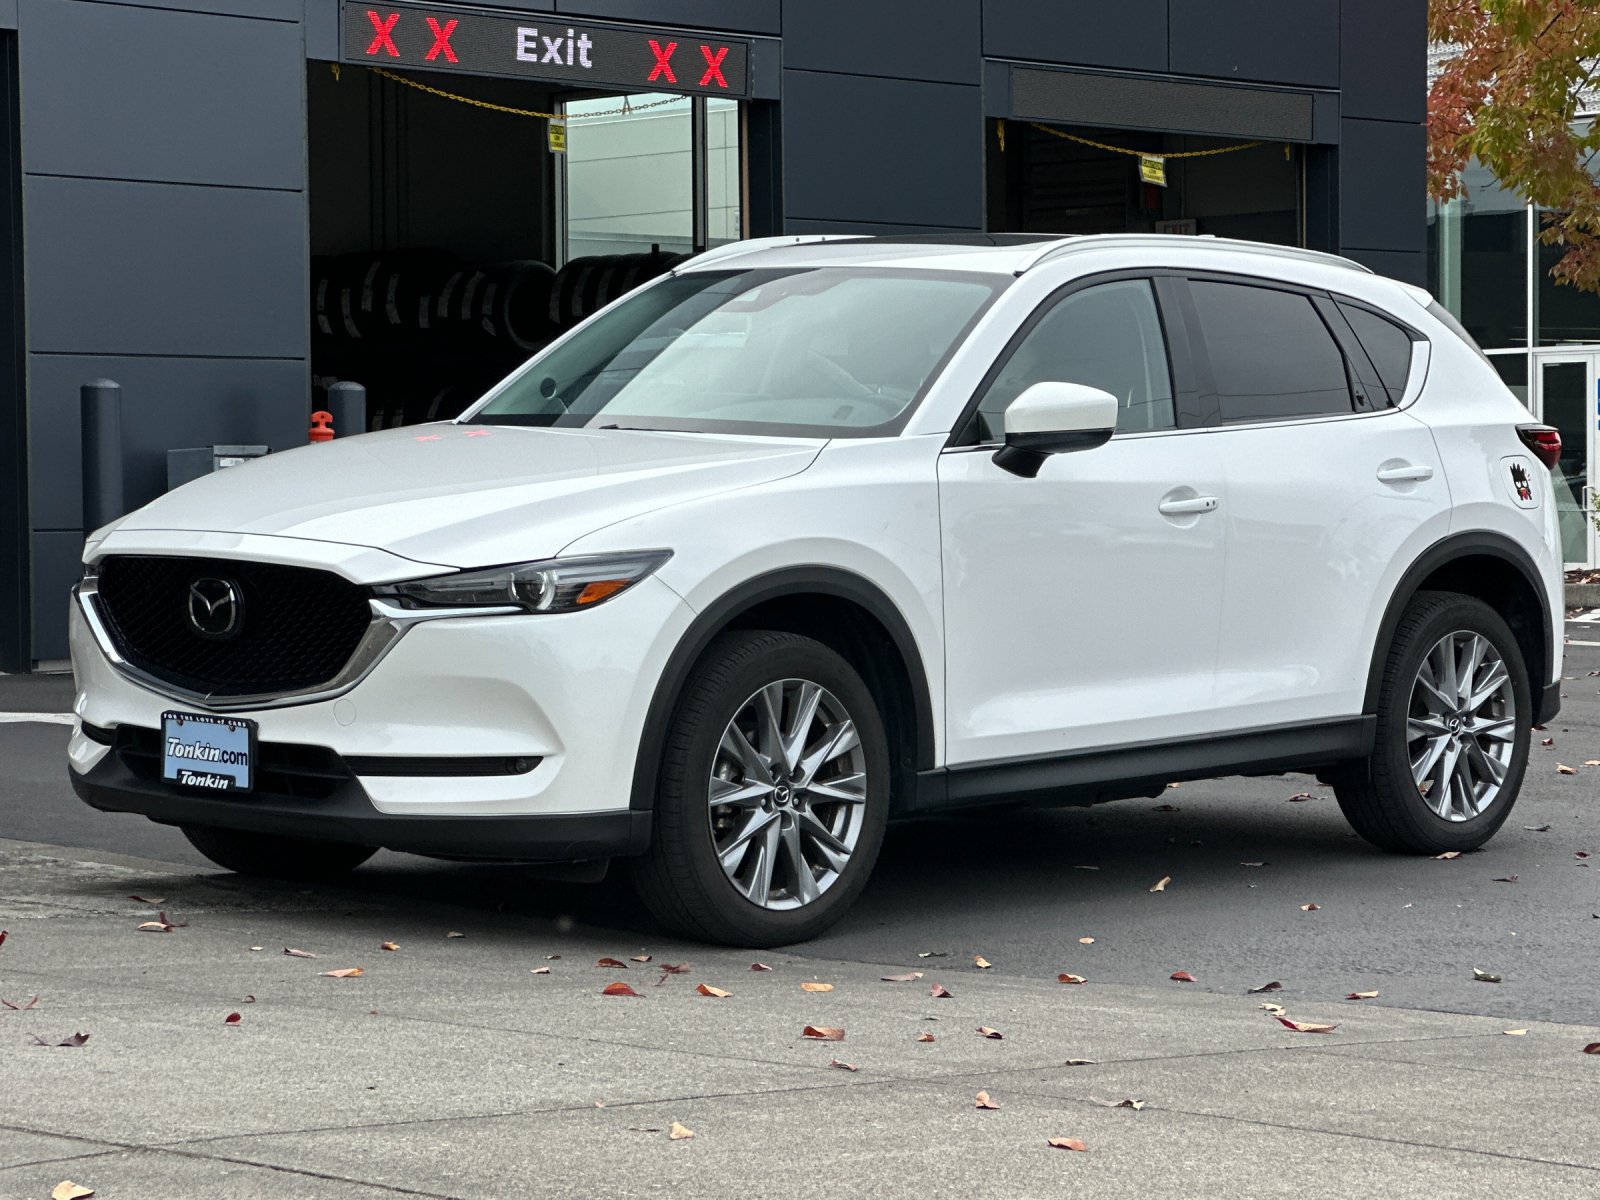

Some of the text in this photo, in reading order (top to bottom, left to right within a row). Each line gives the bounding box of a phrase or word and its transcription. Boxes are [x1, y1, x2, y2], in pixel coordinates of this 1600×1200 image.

[516, 26, 593, 69] Exit
[228, 720, 247, 728] CARS
[167, 737, 248, 766] Tonkin.com
[181, 770, 229, 789] Tonkin
